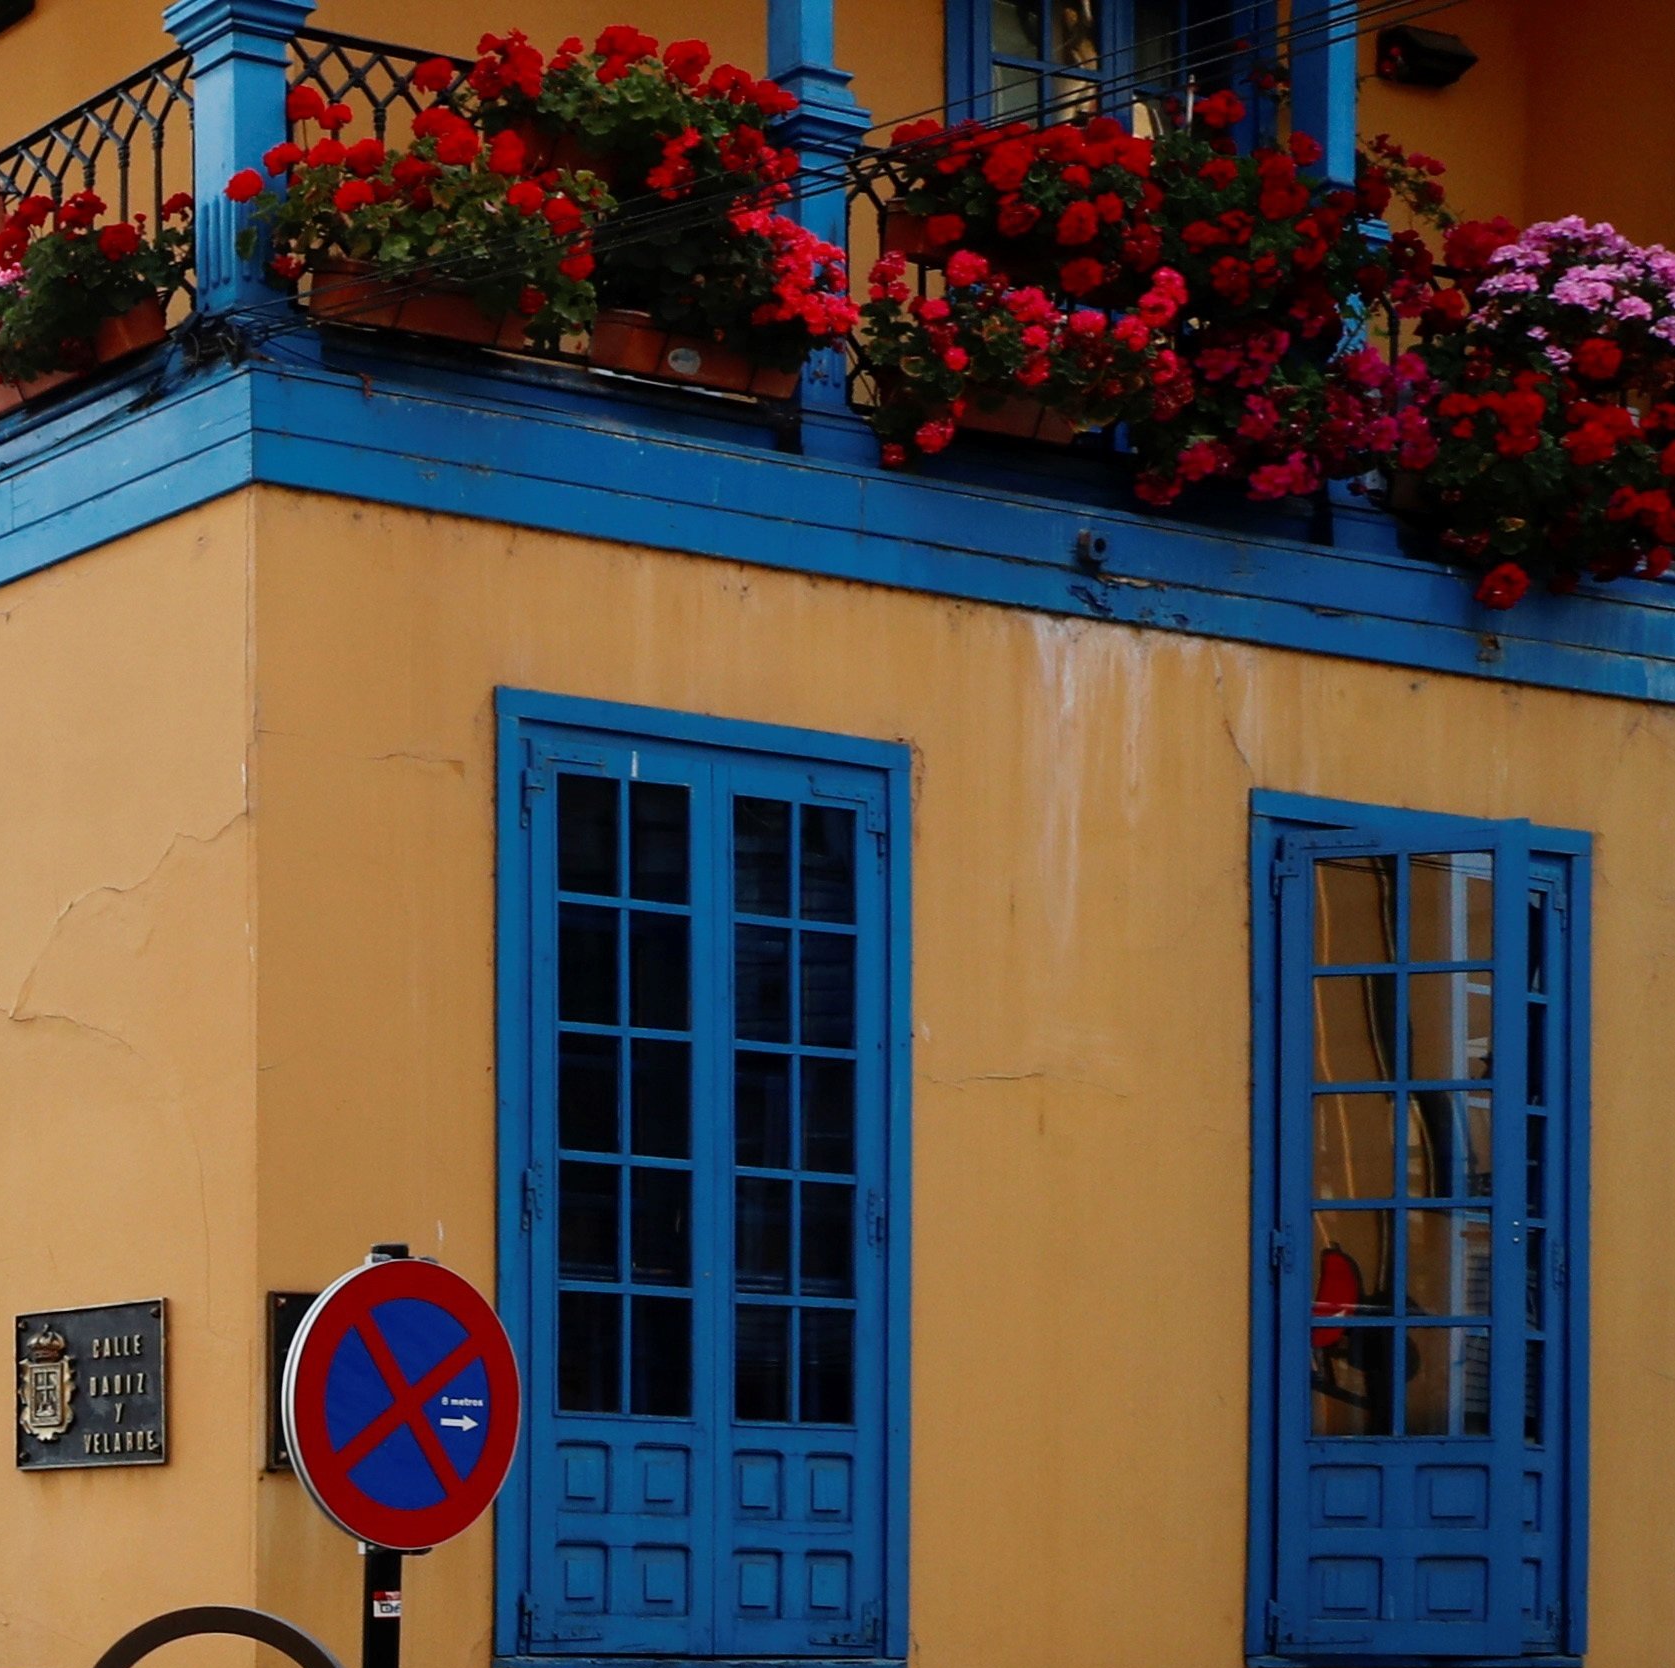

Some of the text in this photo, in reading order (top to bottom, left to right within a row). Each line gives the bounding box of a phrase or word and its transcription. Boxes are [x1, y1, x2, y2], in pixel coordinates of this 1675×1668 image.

[92, 1334, 142, 1358] CALLE
[89, 1373, 146, 1397] DAOIZ
[114, 1402, 124, 1423] Y
[450, 1398, 483, 1407] metros
[83, 1430, 154, 1454] VELARDE
